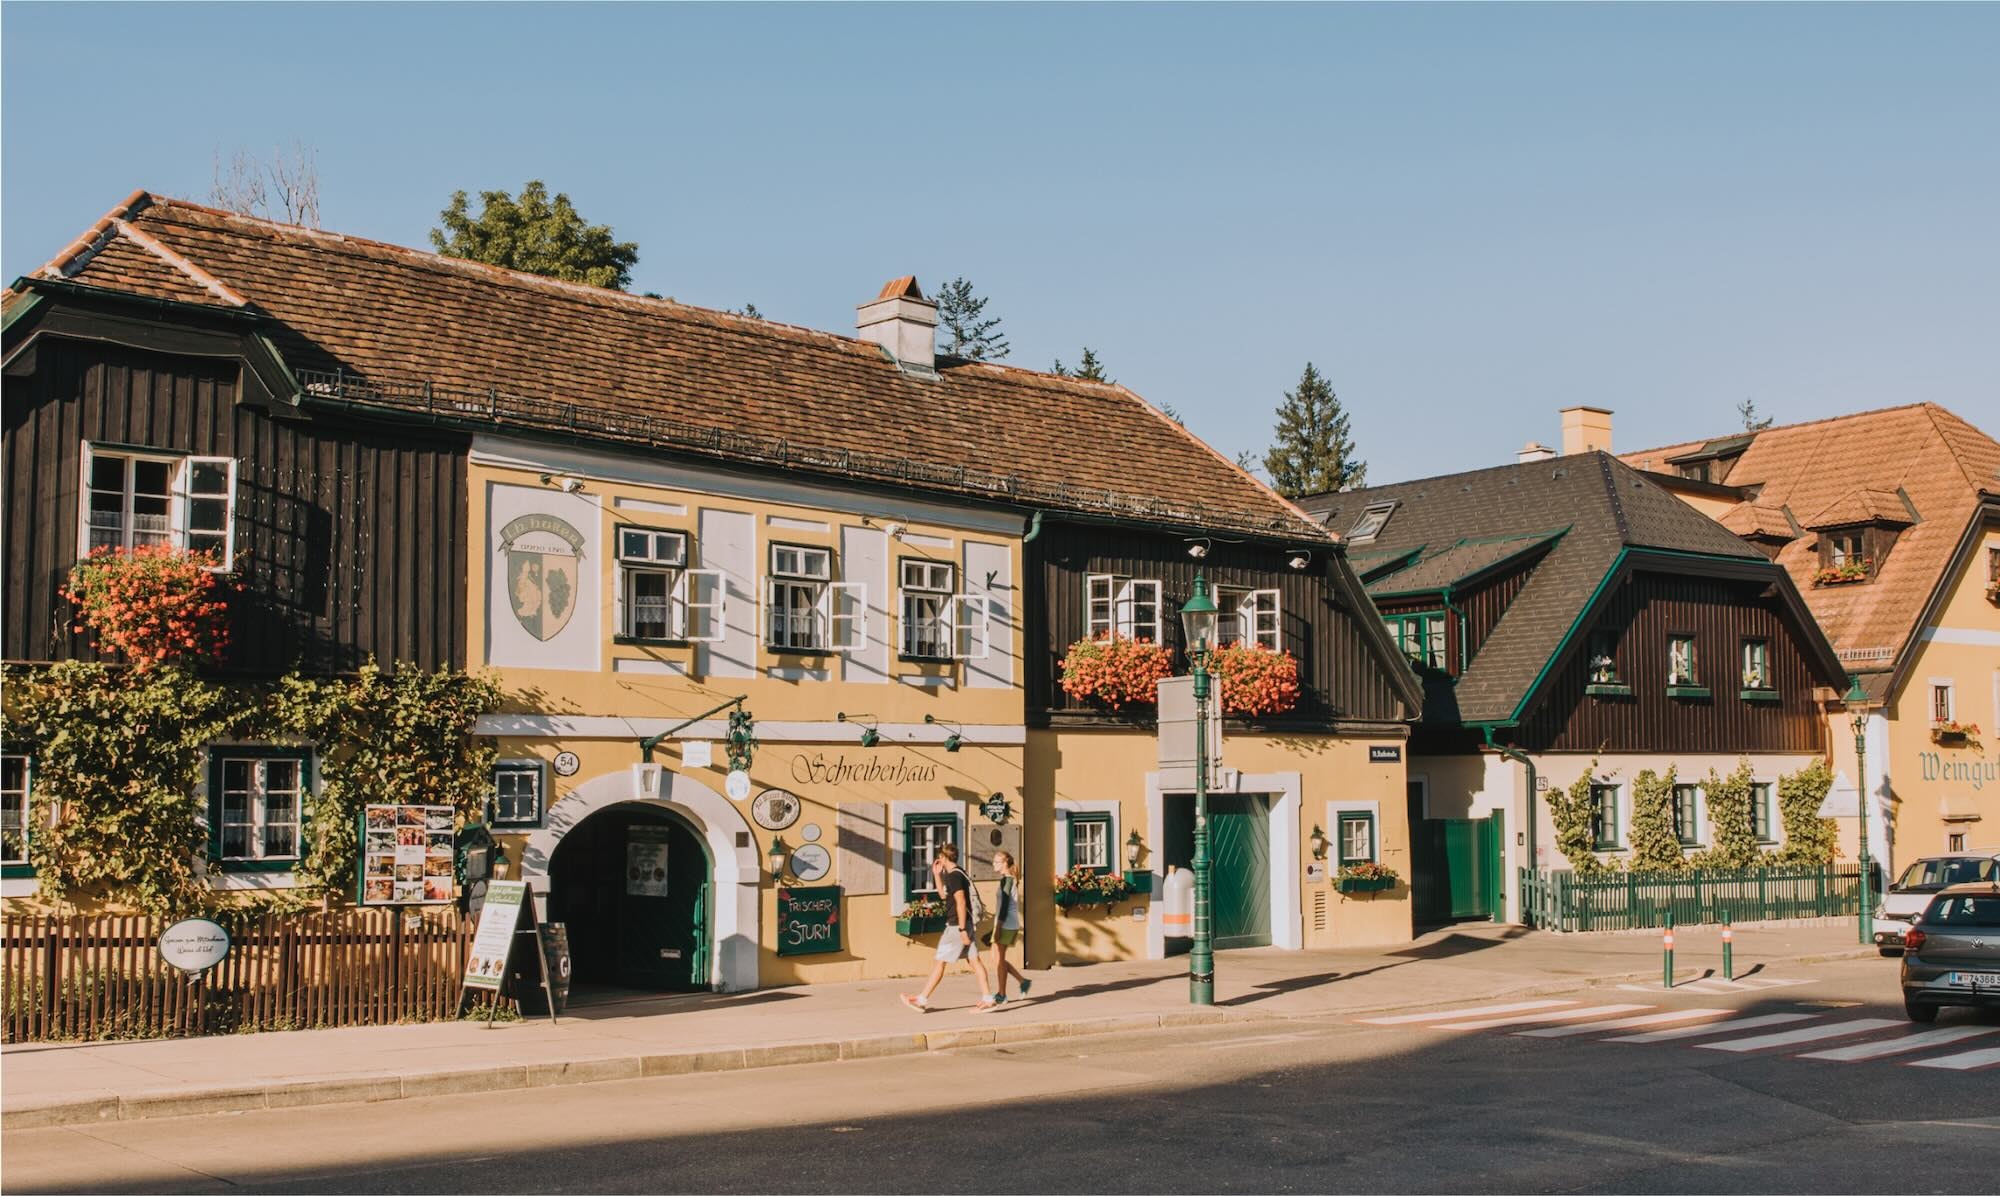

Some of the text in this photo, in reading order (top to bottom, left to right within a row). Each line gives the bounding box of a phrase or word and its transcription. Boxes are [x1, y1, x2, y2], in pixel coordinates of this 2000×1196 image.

[560, 756, 573, 767] 54
[791, 752, 938, 786] Schreiberhaus
[788, 897, 833, 912] FRISCHER
[788, 920, 831, 945] STURM
